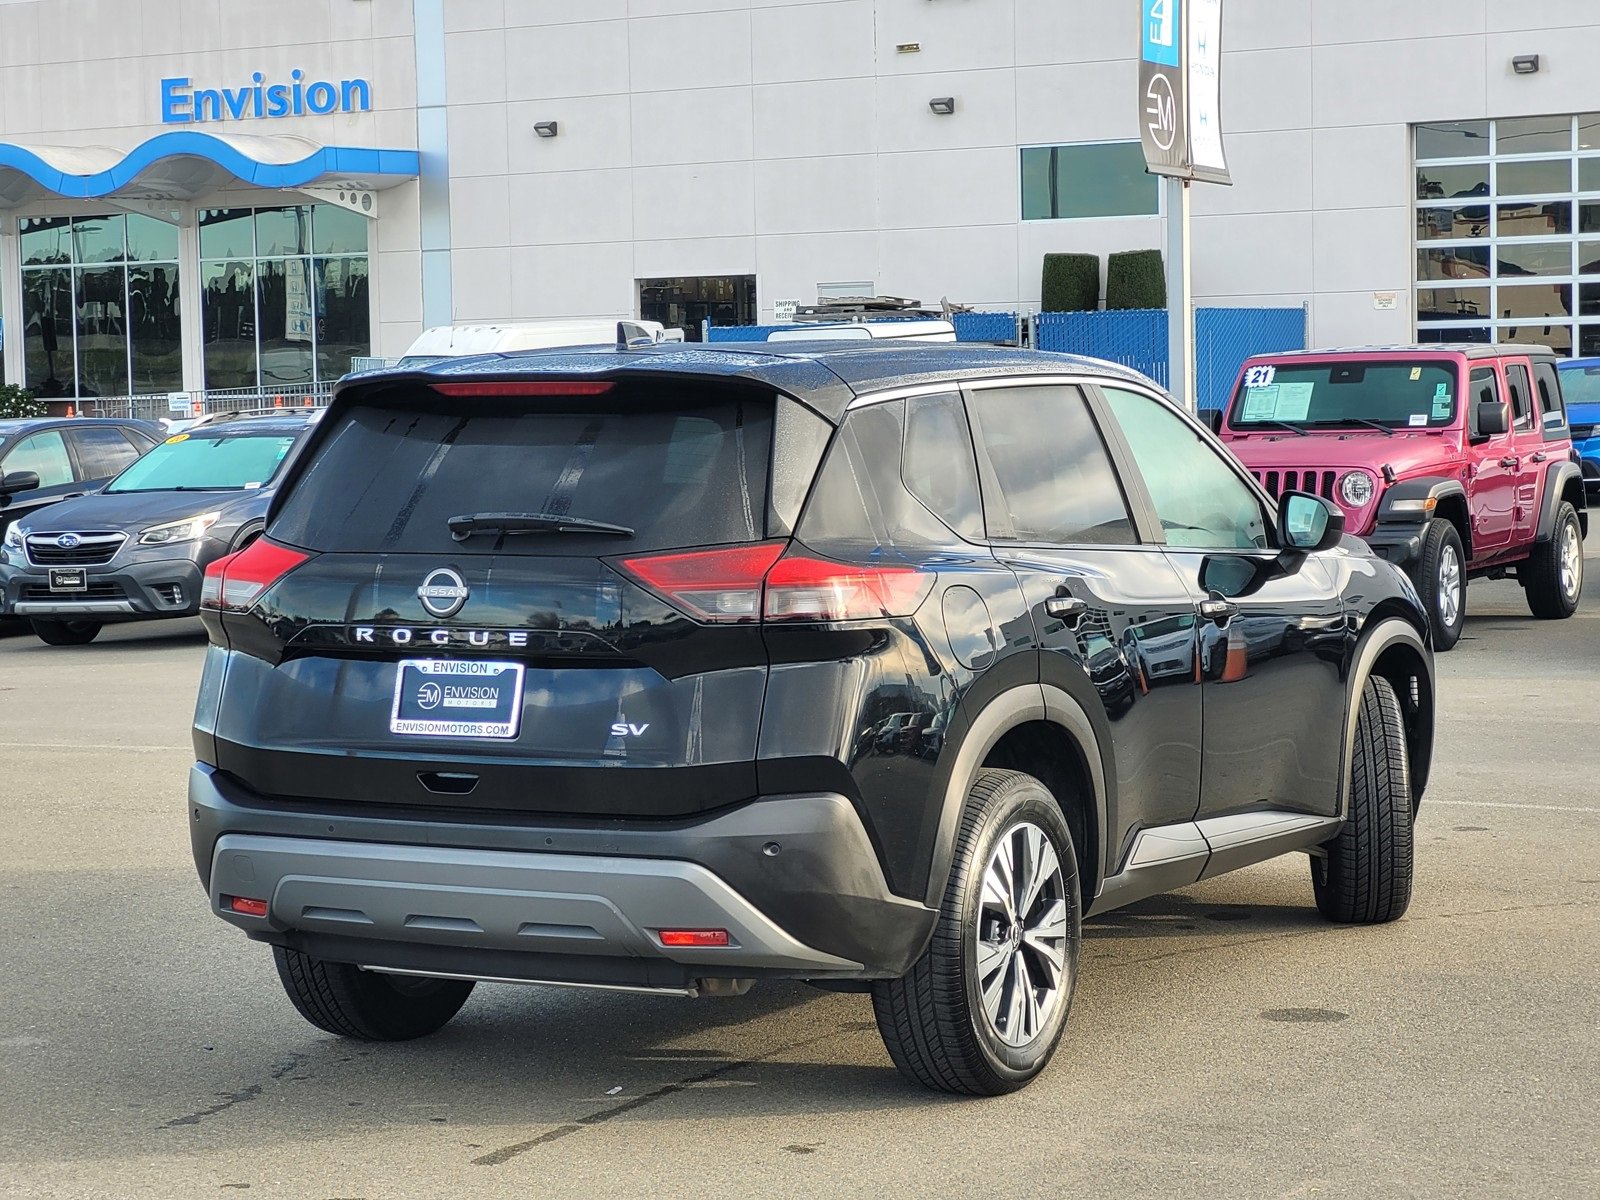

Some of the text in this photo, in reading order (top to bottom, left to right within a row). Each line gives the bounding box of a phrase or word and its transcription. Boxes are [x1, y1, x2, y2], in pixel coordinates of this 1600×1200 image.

[161, 69, 371, 124] Envision
[1251, 370, 1269, 383] 21
[419, 588, 466, 596] NISSAN
[356, 627, 528, 647] ROGUE
[433, 662, 488, 674] ENVISION
[444, 685, 499, 699] ENVISION
[396, 722, 510, 735] ENVISIONMOTORS.COM
[611, 723, 650, 736] SV
